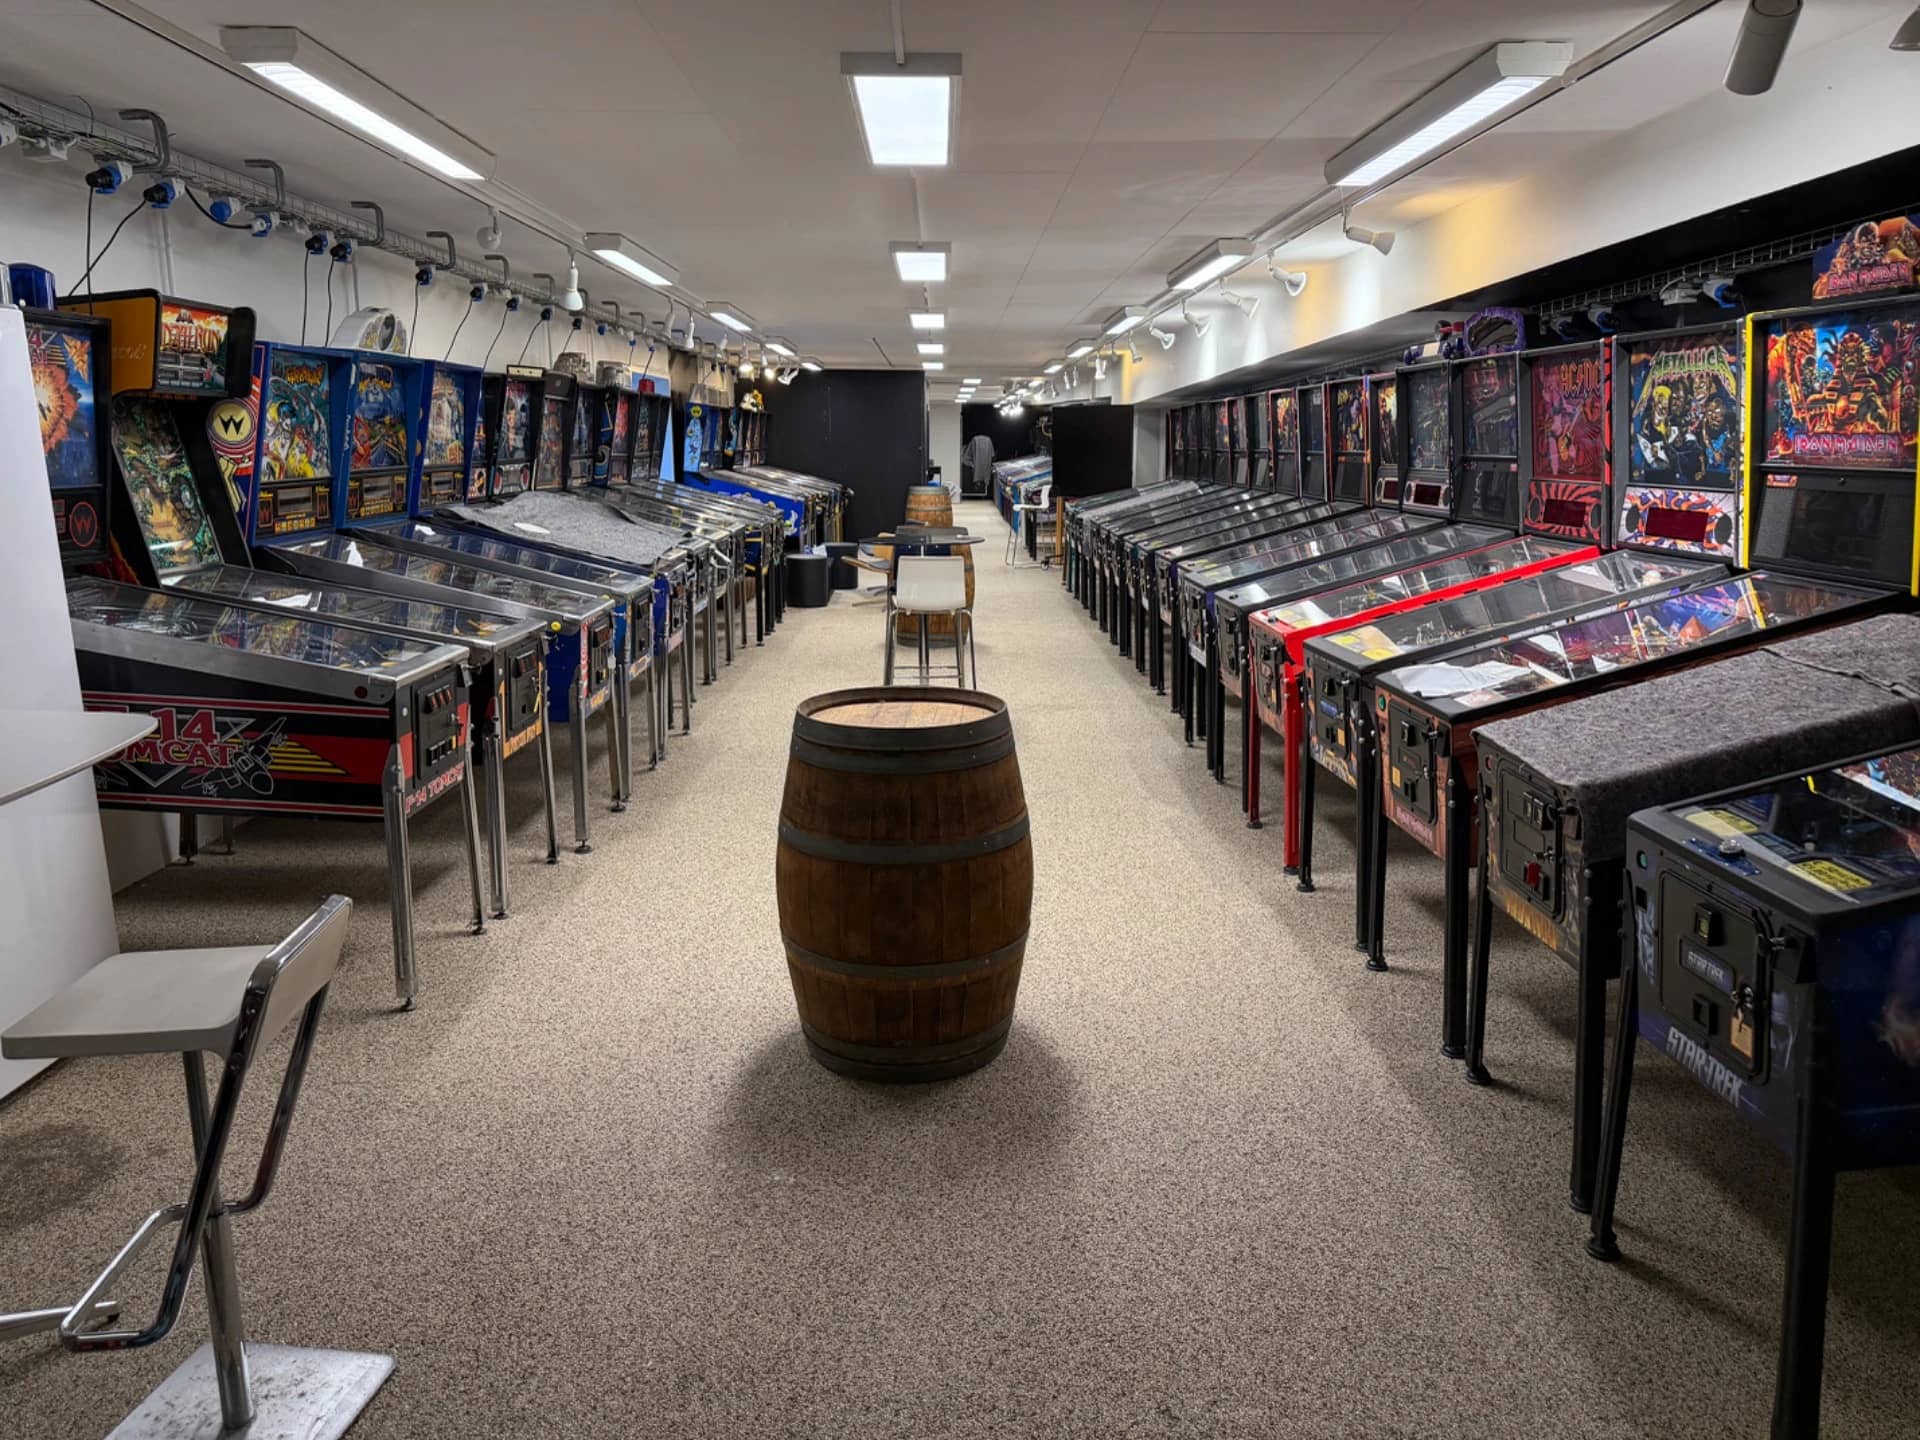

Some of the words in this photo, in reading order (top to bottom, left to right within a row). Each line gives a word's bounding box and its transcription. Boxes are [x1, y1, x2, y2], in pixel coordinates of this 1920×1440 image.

[1828, 270, 1857, 291] IRON
[1858, 262, 1910, 290] MAIDEN
[217, 415, 245, 436] W
[1794, 434, 1833, 455] IRON
[1834, 434, 1897, 455] MAIDEN
[104, 738, 239, 769] MCAT
[1666, 1026, 1705, 1076] STAR
[1704, 1054, 1746, 1108] TREK
